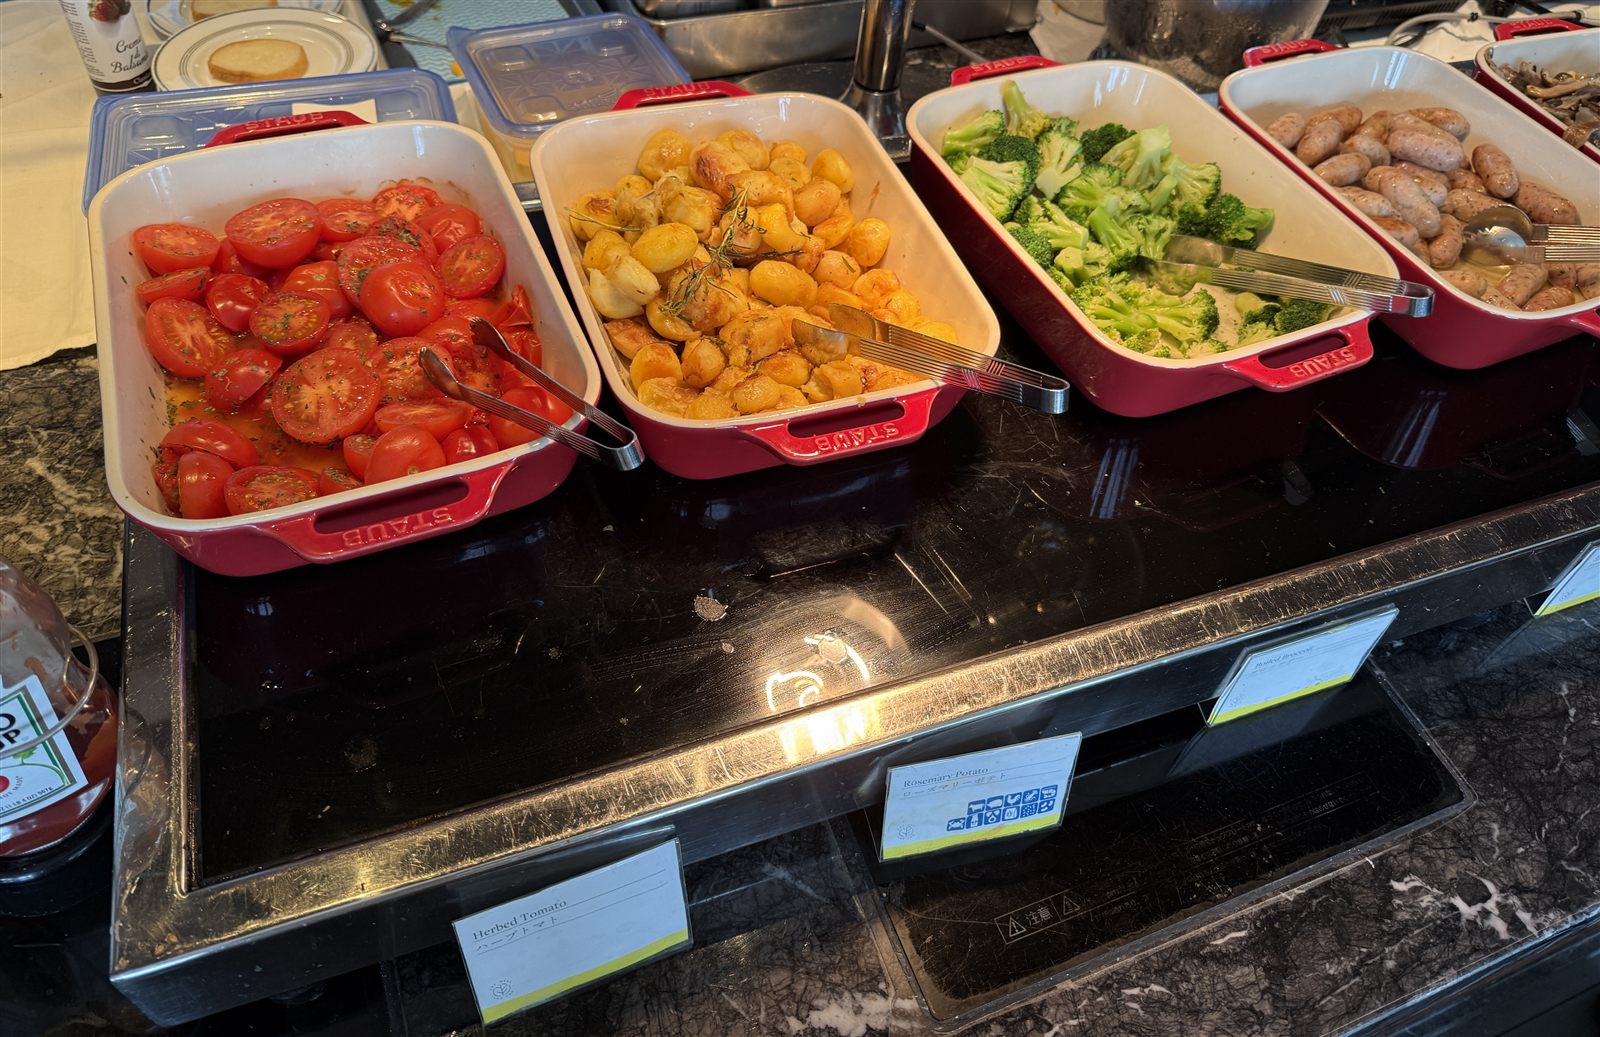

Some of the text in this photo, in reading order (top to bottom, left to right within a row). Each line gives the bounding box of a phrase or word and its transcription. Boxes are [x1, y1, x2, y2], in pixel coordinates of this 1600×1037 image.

[970, 56, 1027, 73] STAUB
[643, 81, 710, 97] STAUB
[244, 111, 324, 131] STAUB
[1288, 348, 1357, 378] STAUB
[814, 422, 900, 452] STAUB
[341, 506, 454, 547] STAUB
[902, 766, 989, 788] Rosemary Potato
[472, 899, 568, 941] Herbed Tomato
[1024, 905, 1054, 927] 注意
